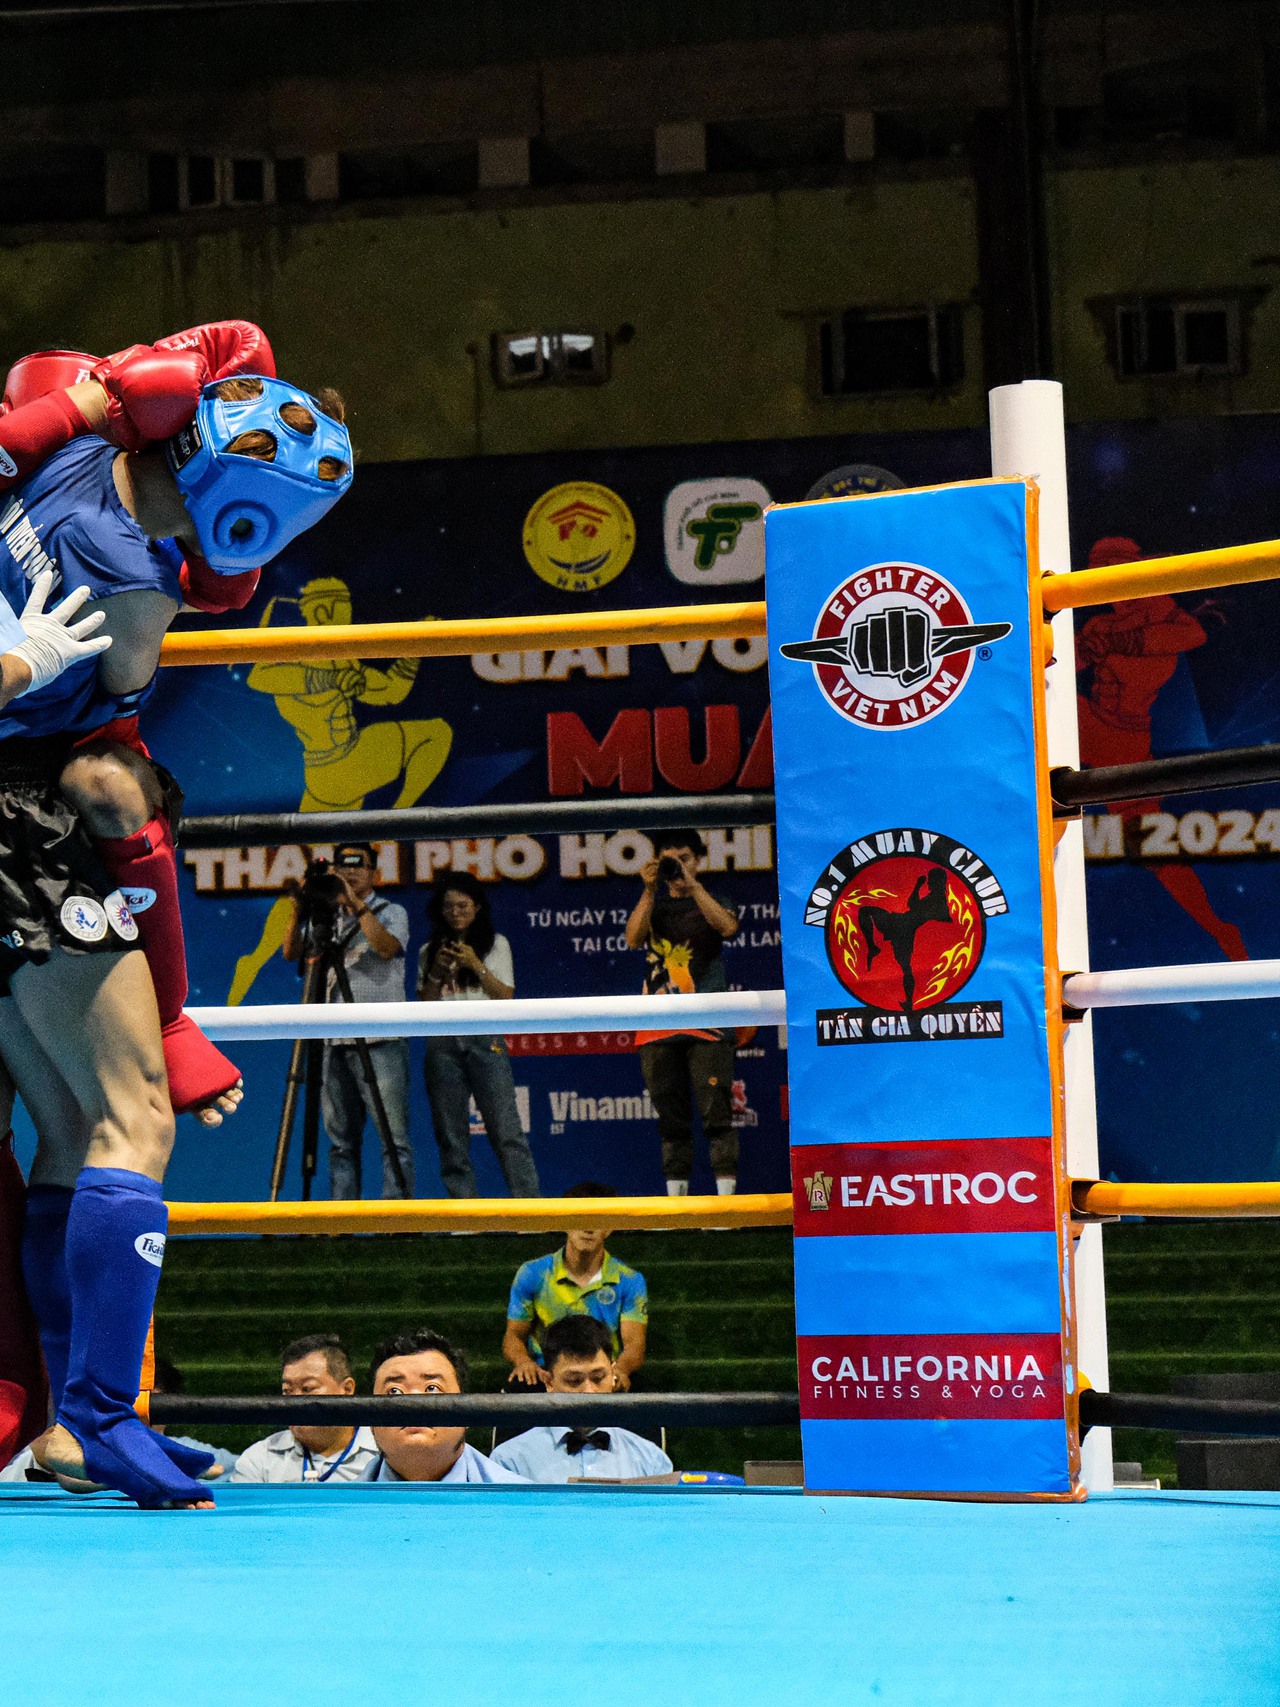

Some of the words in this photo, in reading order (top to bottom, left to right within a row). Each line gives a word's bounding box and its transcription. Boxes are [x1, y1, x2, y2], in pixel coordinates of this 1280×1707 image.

[829, 570, 951, 620] FIGHTER
[831, 679, 890, 723] VIET
[898, 670, 959, 722] NAM
[1140, 809, 1280, 857] 2024
[851, 831, 939, 867] MUAY
[949, 848, 1008, 917] CLUB
[549, 1089, 660, 1122] Vinami
[841, 1171, 1038, 1208] EASTROC
[811, 1355, 1044, 1381] CALIFORNIA
[814, 1385, 920, 1399] FITNESS
[941, 1386, 953, 1398] &
[971, 1385, 1045, 1398] YOGA
